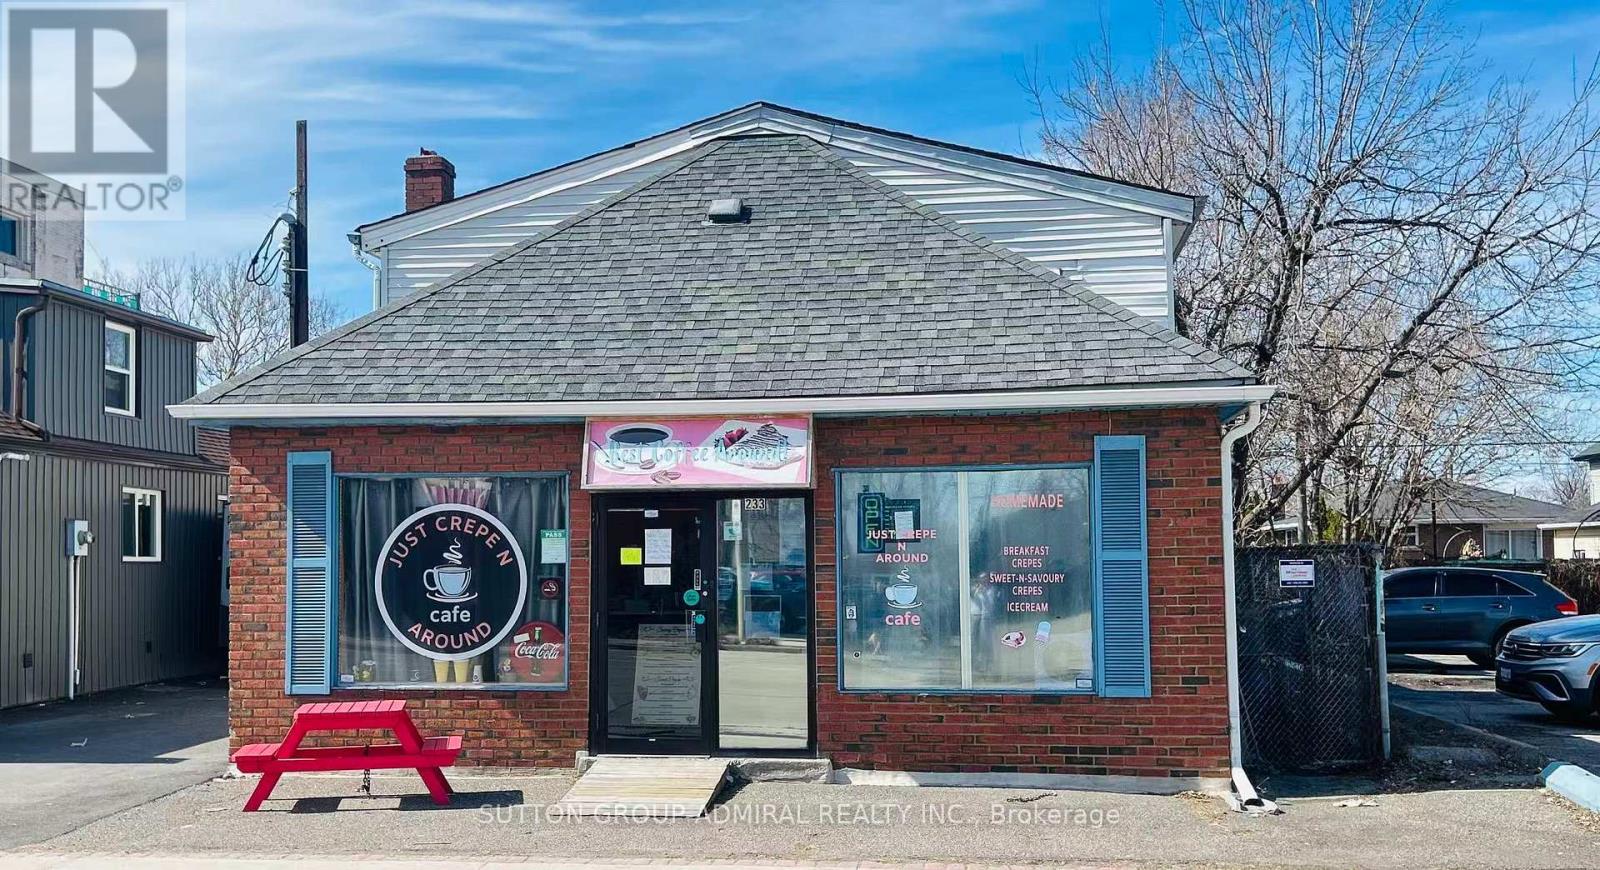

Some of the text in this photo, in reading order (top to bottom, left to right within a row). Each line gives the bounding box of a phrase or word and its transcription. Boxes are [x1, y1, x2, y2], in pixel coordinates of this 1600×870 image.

[745, 498, 766, 510] 233
[867, 530, 937, 539] JUST REPE
[390, 516, 513, 568] JUST CREPE N
[897, 543, 906, 551] N
[1003, 546, 1050, 556] BREAKFAST
[876, 554, 929, 563] AROUND
[1011, 558, 1042, 568] CREPES
[989, 573, 1065, 583] SWEET-N-SAVOURY
[1012, 587, 1043, 596] CREPES
[1007, 602, 1049, 612] ICECREAM
[429, 605, 471, 623] cafe
[885, 611, 921, 626] cafe
[407, 622, 492, 650] AROUND
